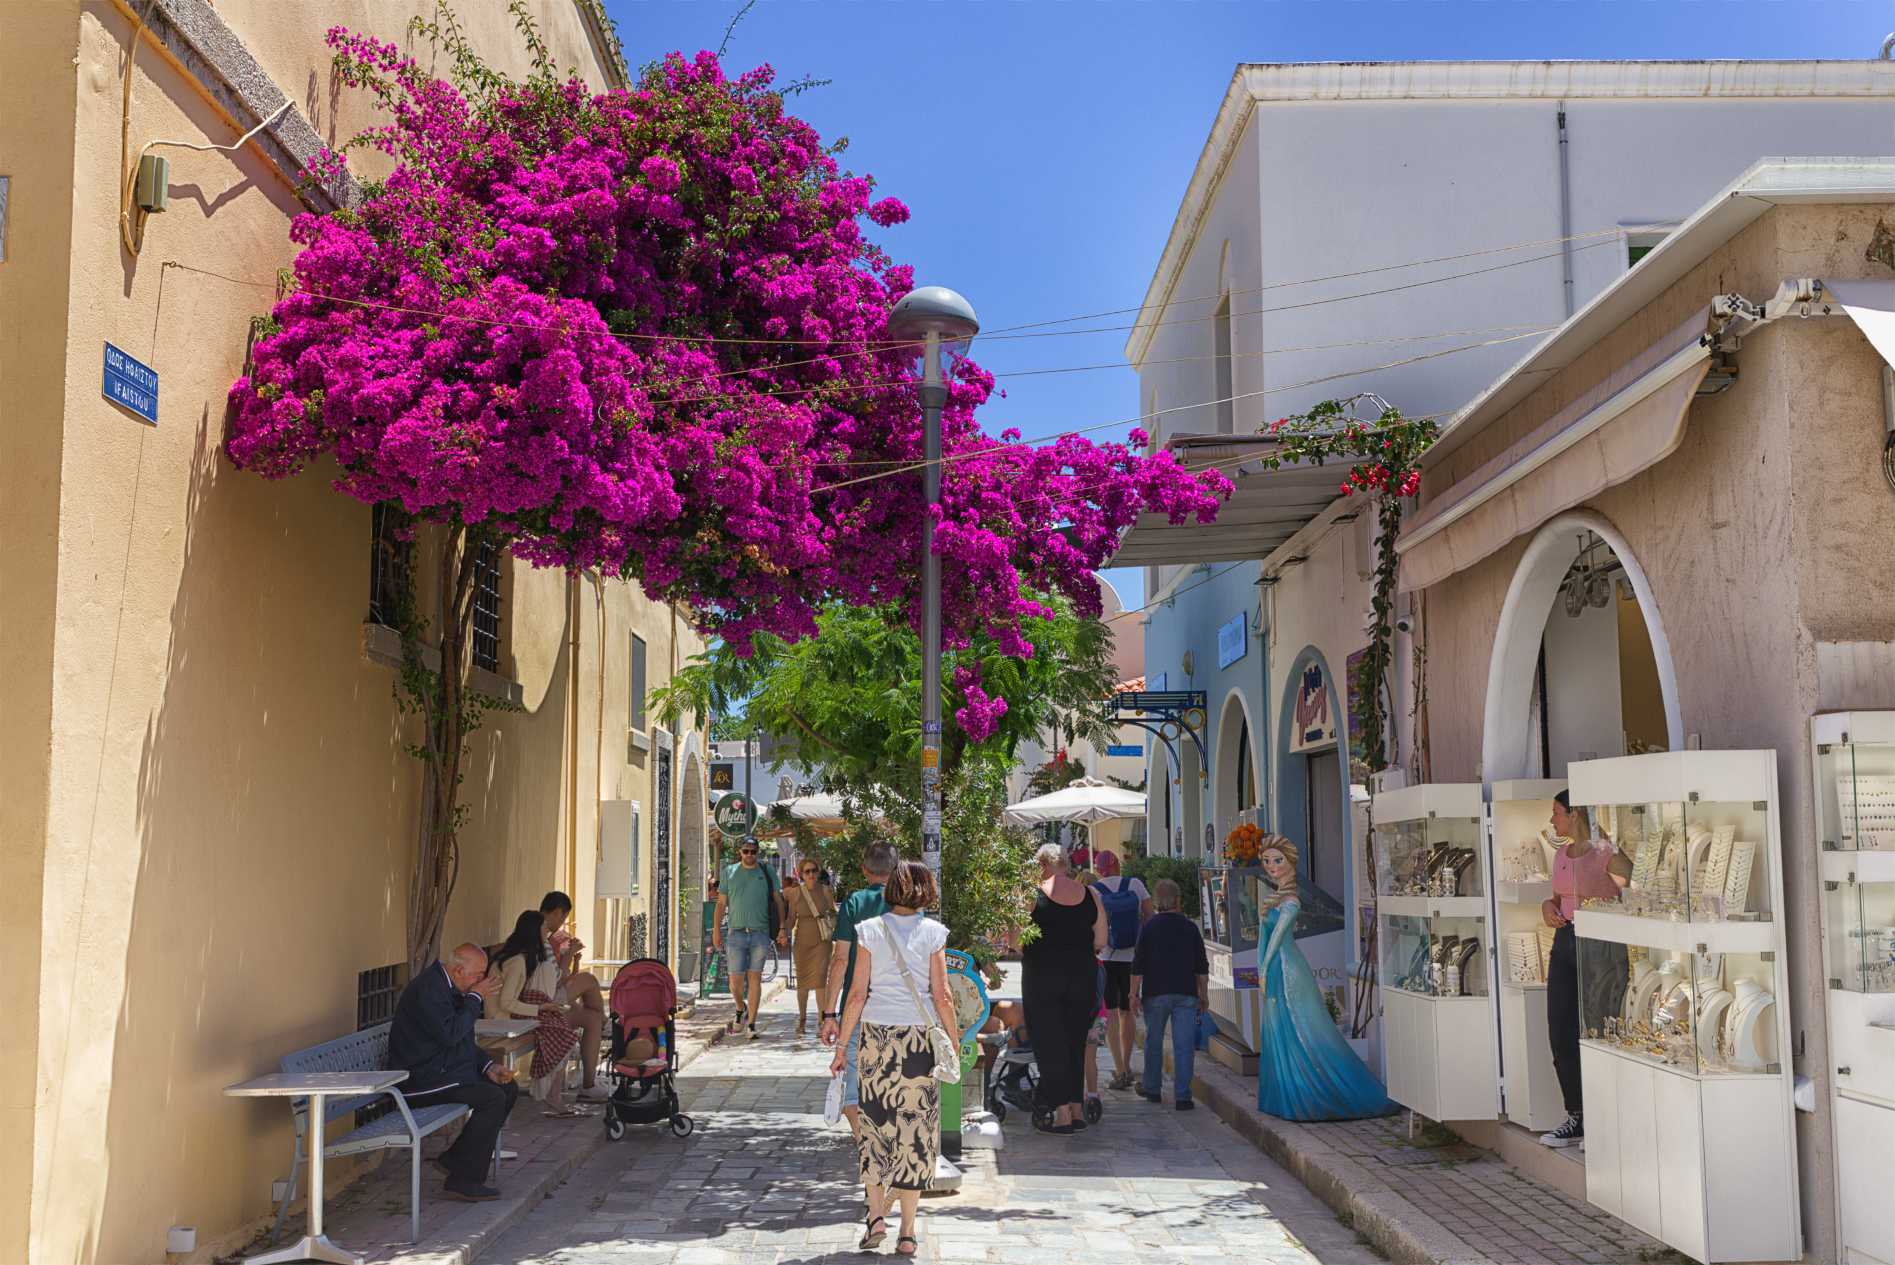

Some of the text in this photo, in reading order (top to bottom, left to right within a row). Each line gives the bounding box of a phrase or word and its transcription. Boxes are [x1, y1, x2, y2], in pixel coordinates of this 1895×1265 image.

[106, 348, 123, 370] ΟΔΟΣ
[114, 380, 149, 412] IFAISTOU
[946, 955, 966, 970] RY'S
